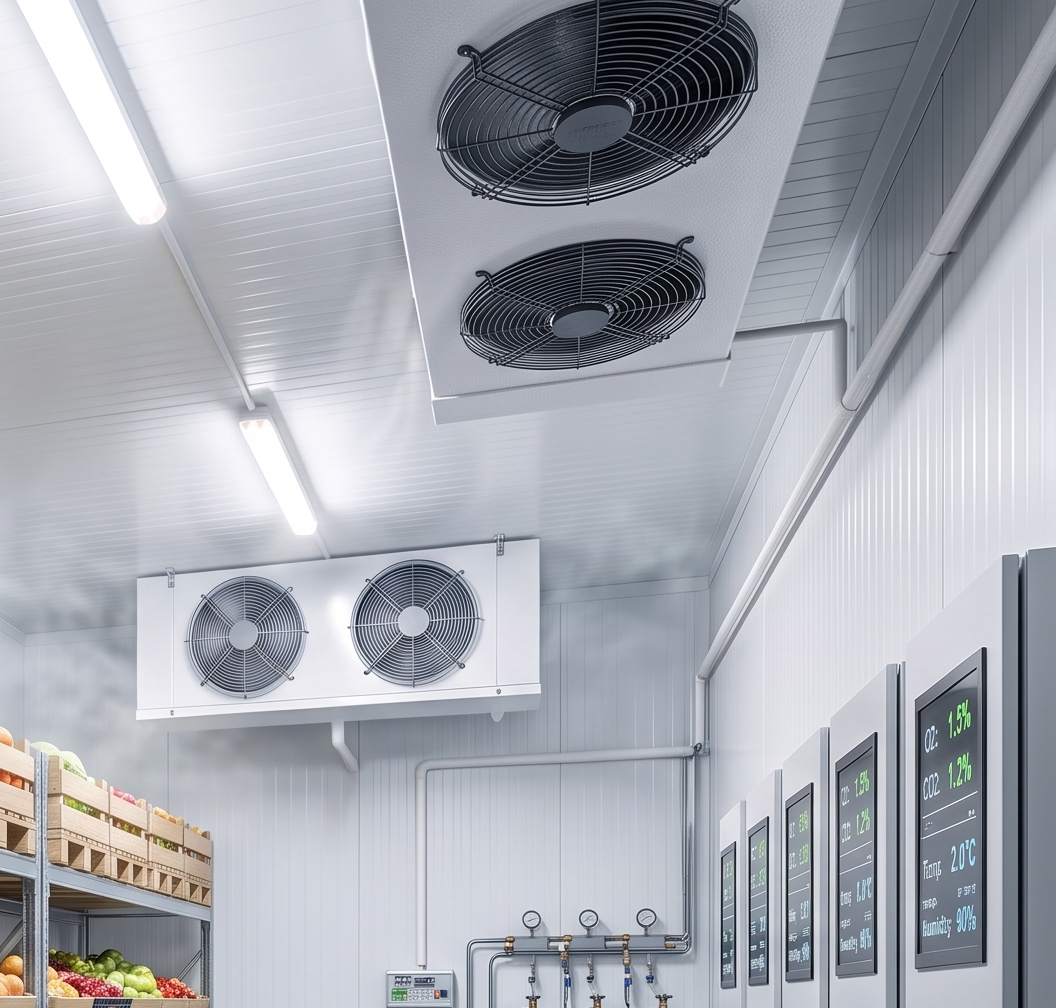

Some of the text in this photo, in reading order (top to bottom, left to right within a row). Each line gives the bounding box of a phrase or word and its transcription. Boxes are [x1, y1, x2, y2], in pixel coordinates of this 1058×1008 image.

[948, 699, 972, 739] 1.5%
[923, 752, 972, 800] CO2 1.2%
